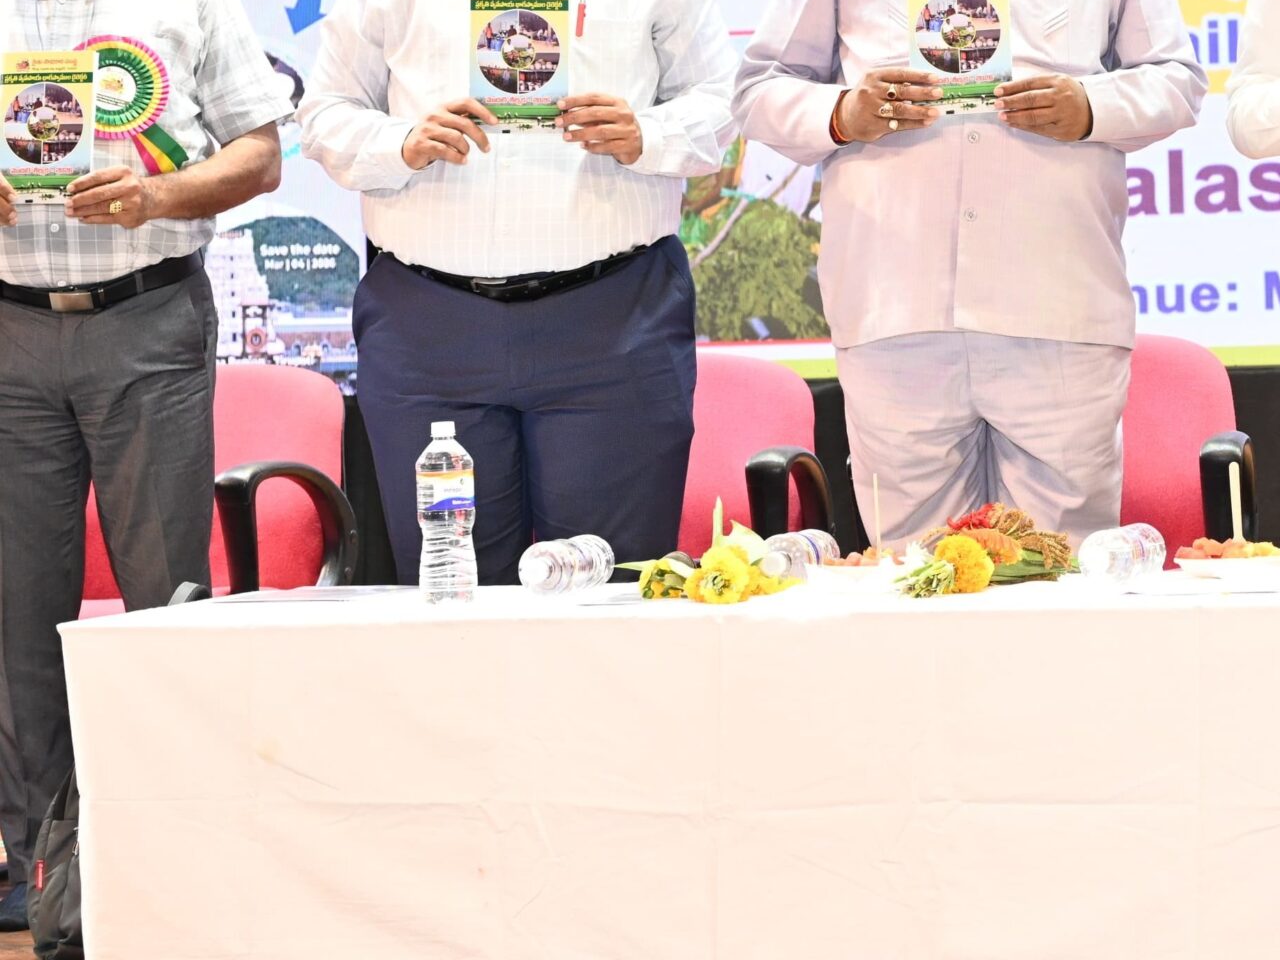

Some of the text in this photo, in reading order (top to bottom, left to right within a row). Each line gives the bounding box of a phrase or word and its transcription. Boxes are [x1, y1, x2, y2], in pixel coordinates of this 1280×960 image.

[259, 242, 341, 257] Save the date
